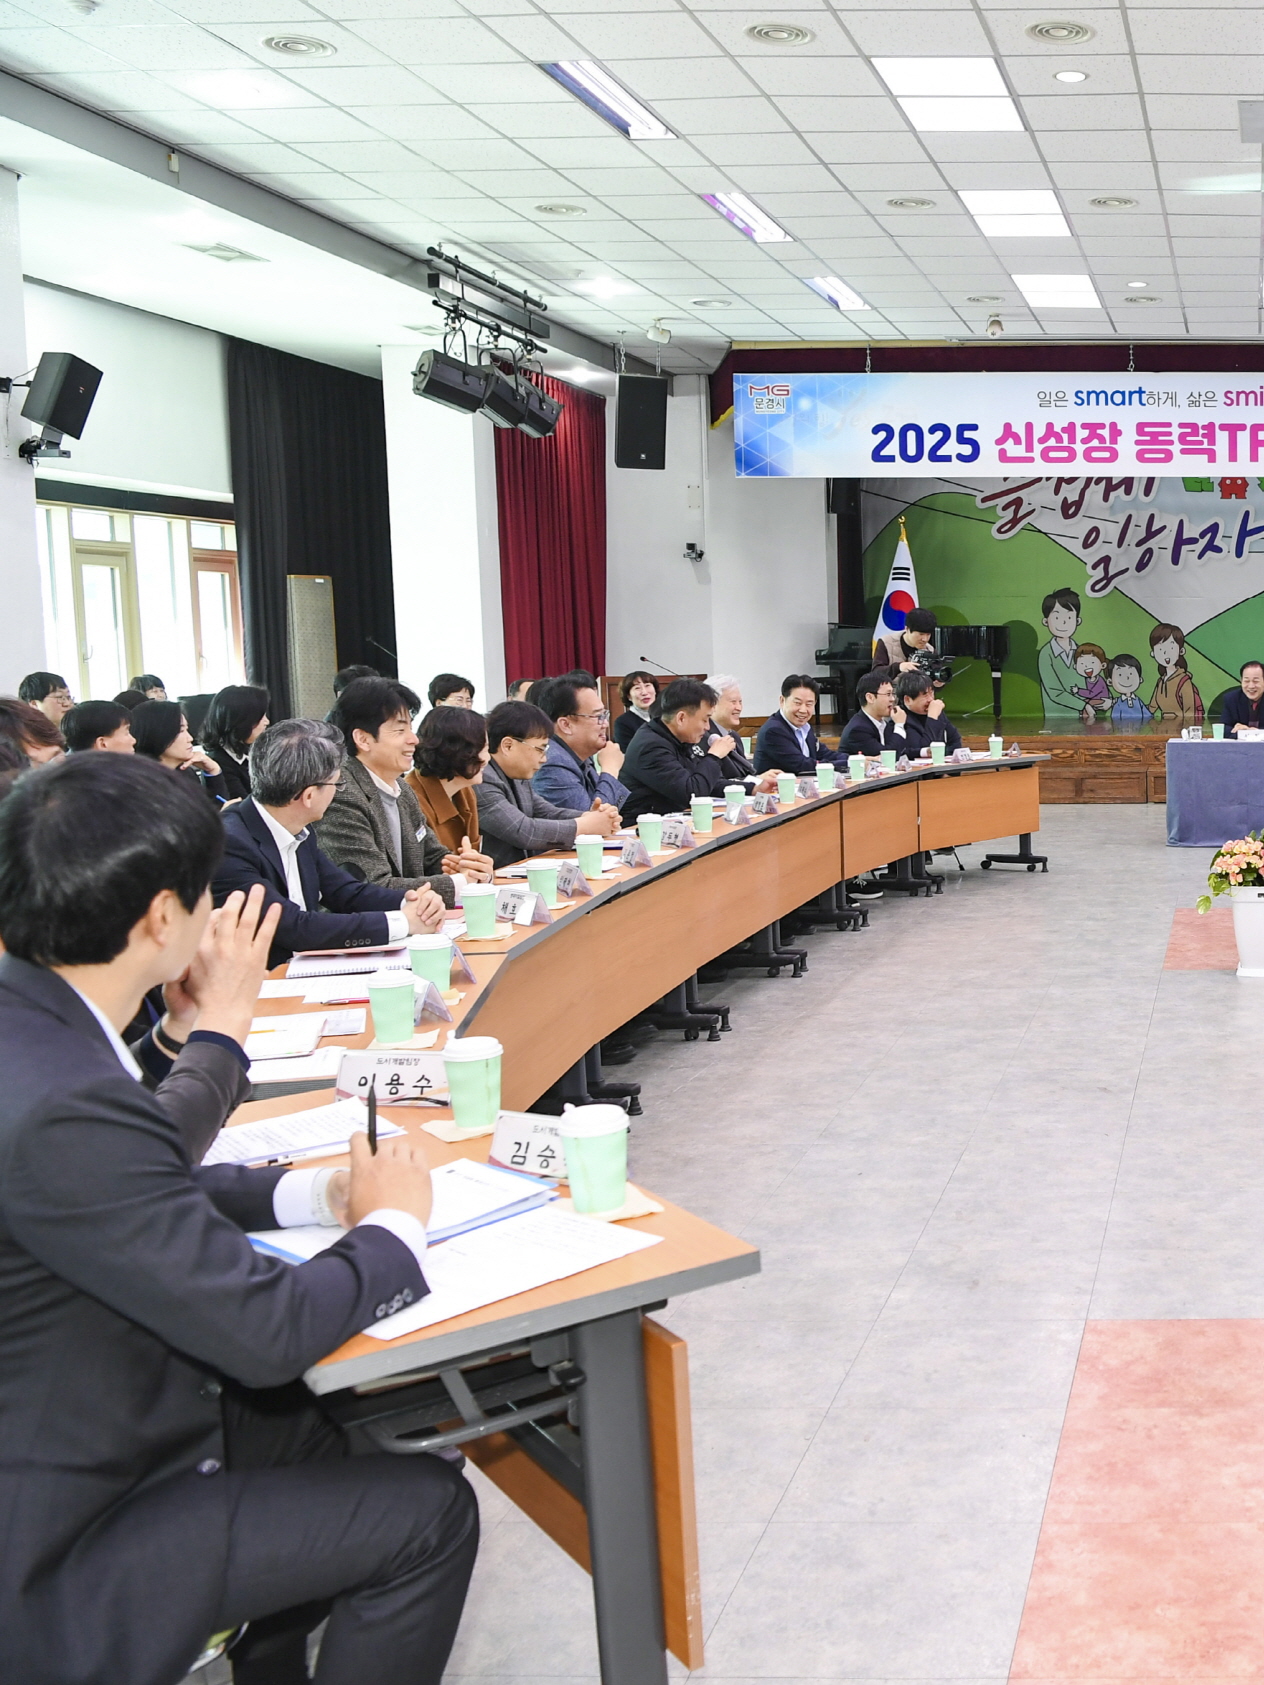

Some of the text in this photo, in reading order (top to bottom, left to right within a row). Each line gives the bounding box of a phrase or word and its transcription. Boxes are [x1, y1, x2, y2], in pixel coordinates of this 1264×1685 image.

[749, 384, 790, 397] MG
[1036, 390, 1069, 408] 일은
[1073, 386, 1181, 409] smart하게,
[1186, 390, 1219, 408] 삶은
[754, 397, 785, 410] 문경시
[871, 422, 981, 463] 2025
[994, 421, 1123, 464] 신성장
